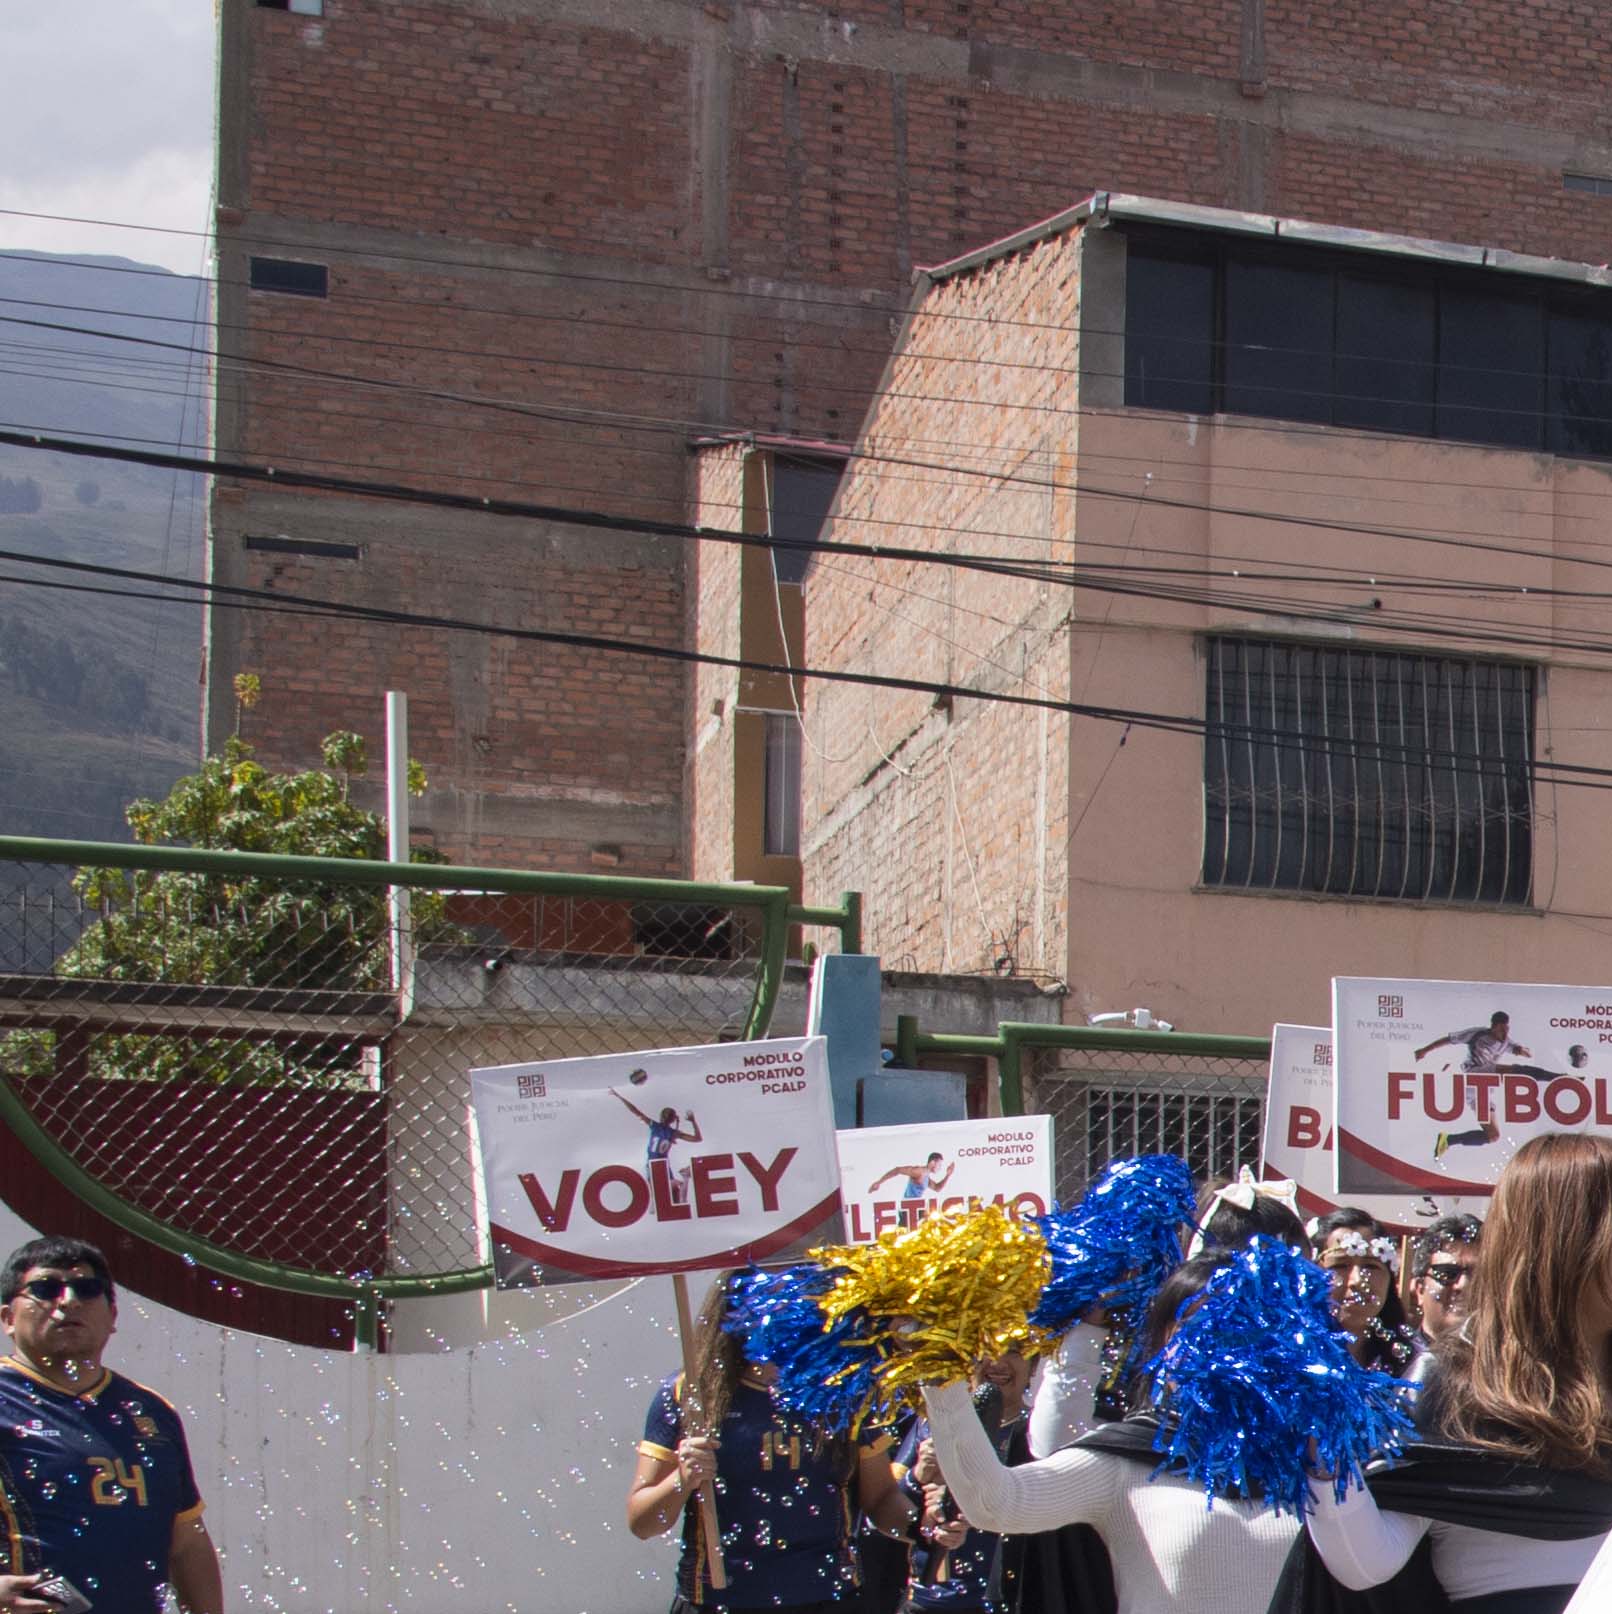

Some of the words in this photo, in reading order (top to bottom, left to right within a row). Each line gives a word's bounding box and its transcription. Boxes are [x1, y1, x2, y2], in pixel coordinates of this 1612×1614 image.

[705, 1066, 805, 1085] CORPORATIVO
[761, 1081, 806, 1095] PCALP
[957, 1144, 1034, 1158] CORPORATIVO
[1000, 1156, 1035, 1167] PCALP
[517, 1147, 799, 1233] VOLEY
[762, 1430, 800, 1471] 14
[85, 1456, 149, 1506] 24
